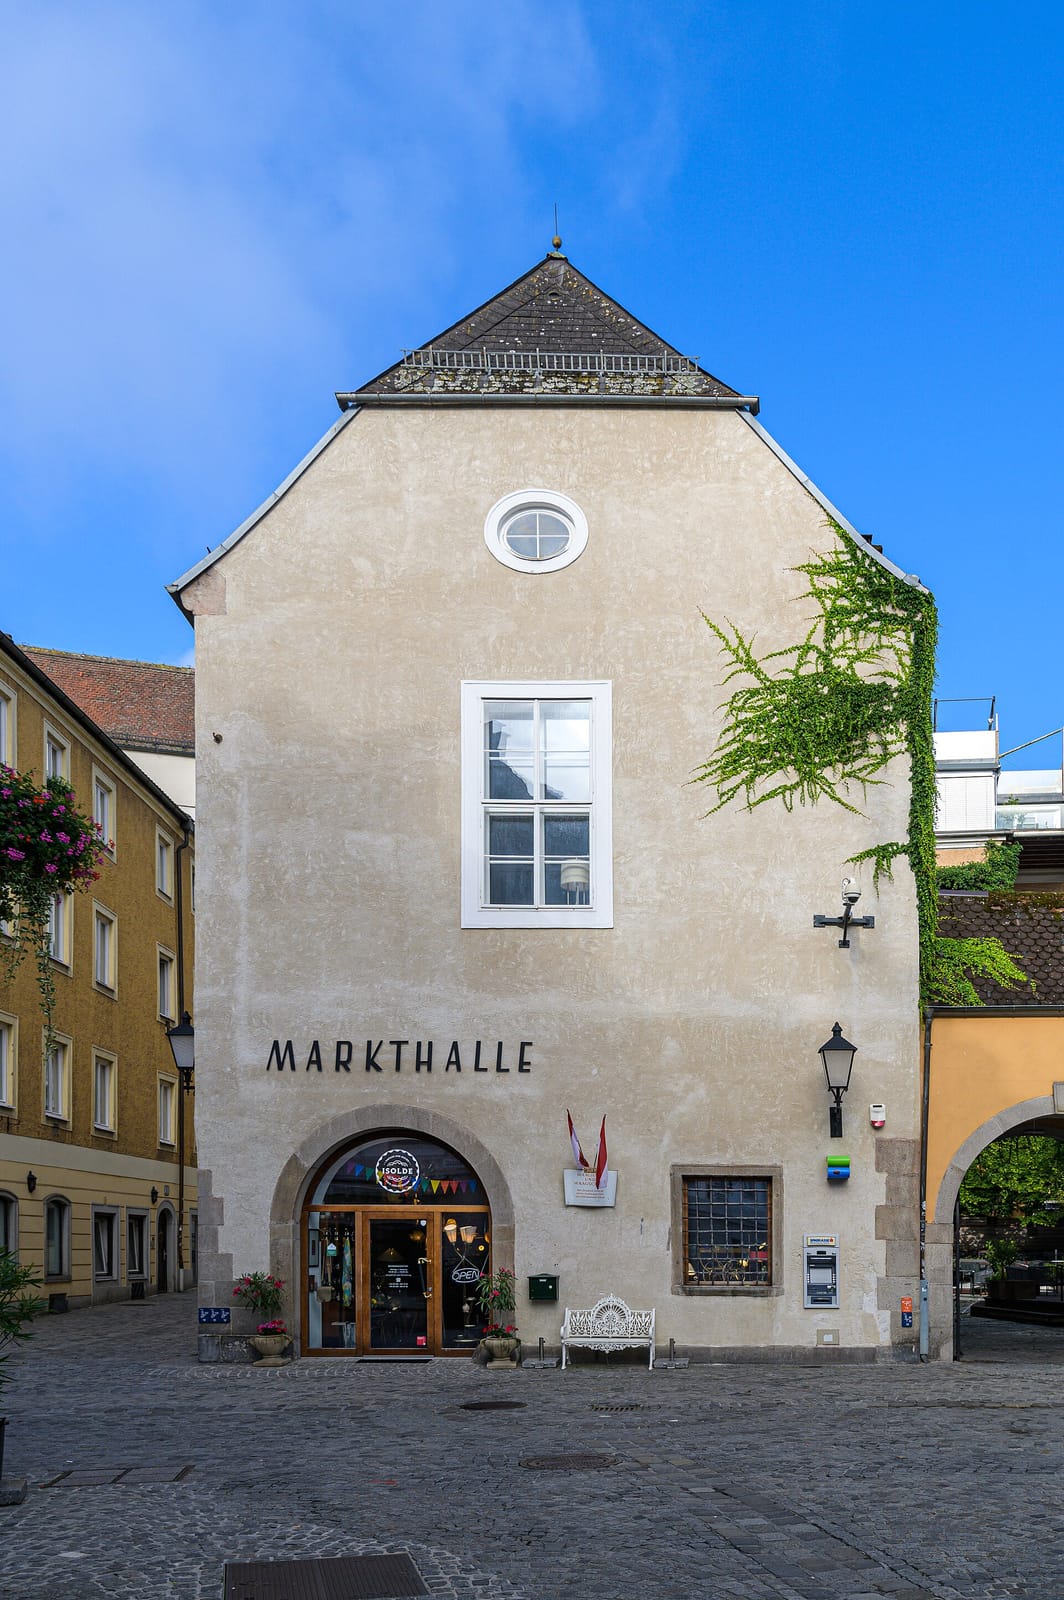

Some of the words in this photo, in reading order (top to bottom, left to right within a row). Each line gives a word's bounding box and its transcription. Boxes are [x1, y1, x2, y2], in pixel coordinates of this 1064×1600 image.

[266, 1039, 534, 1074] MARKTHALLE
[382, 1167, 413, 1175] ISOLDE
[453, 1270, 479, 1280] OPEN
